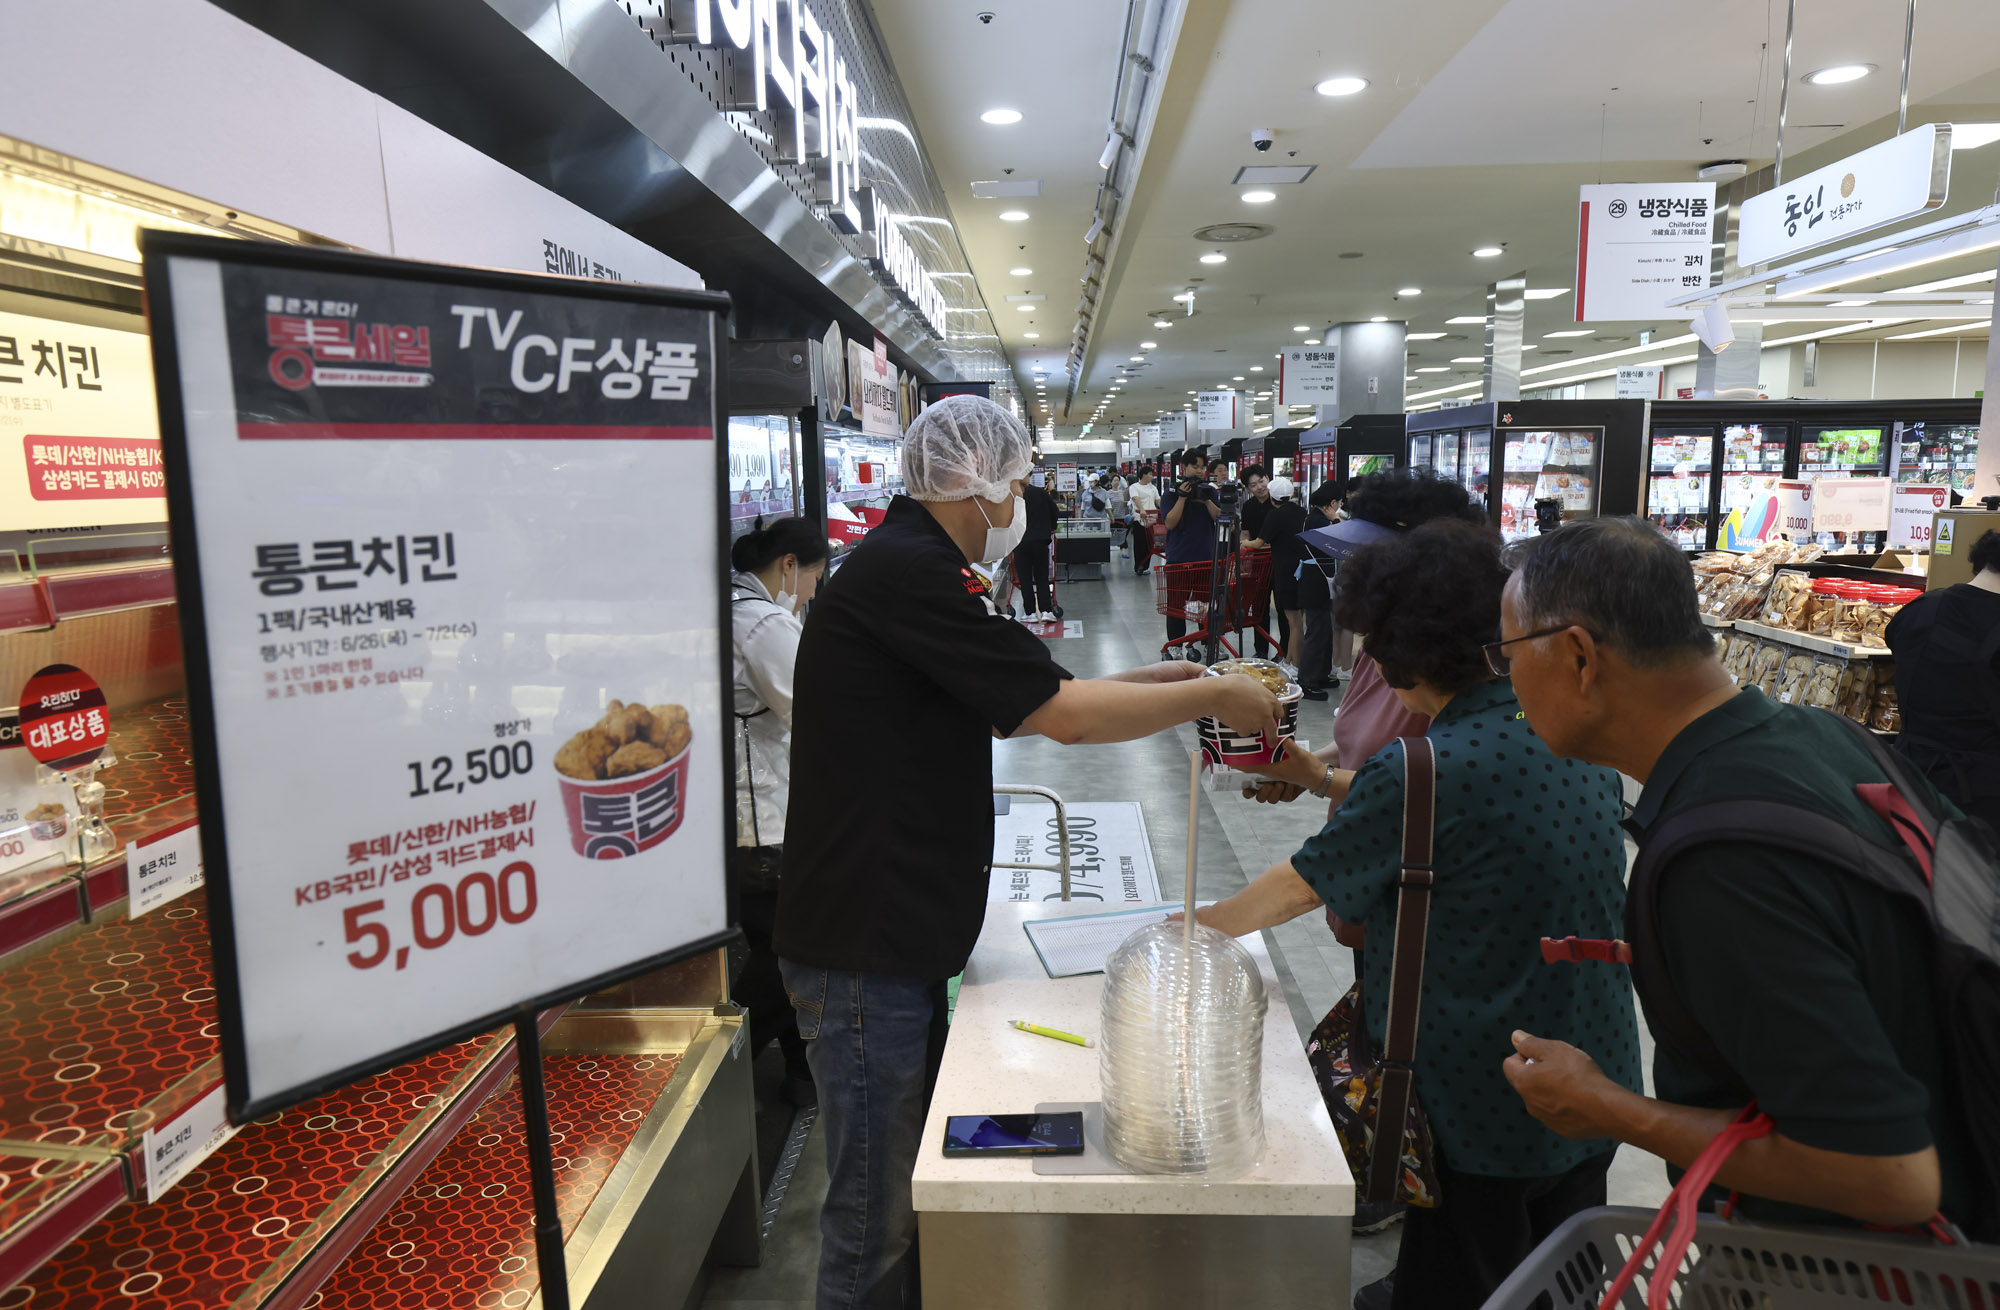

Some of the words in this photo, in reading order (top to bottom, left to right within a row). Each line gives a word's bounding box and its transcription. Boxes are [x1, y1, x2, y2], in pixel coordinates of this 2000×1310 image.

[1610, 201, 1626, 216] 29
[1638, 198, 1708, 218] 냉장식품
[1684, 255, 1703, 266] 김치
[1682, 276, 1702, 287] 반찬
[267, 313, 432, 391] 통큰세일
[450, 304, 524, 351] TV
[510, 334, 700, 401] CF상품
[1305, 352, 1335, 361] 냉동식품
[31, 339, 102, 391] 치킨
[42, 470, 100, 491] 삼성카드
[101, 470, 140, 490] 결제시
[1786, 516, 1808, 530] 10,000
[1735, 535, 1765, 548] SUMMER
[252, 532, 457, 597] 통큰치킨
[257, 598, 415, 634] 1팩/국내산계육
[260, 638, 330, 663] 행사기간
[341, 629, 408, 653] 6/26(목)
[40, 688, 81, 709] 요리하다
[28, 708, 105, 748] 대표상품
[493, 718, 532, 738] 정상가
[407, 740, 534, 798] 12,500
[158, 850, 177, 868] 치킨
[342, 860, 538, 971] 5,000
